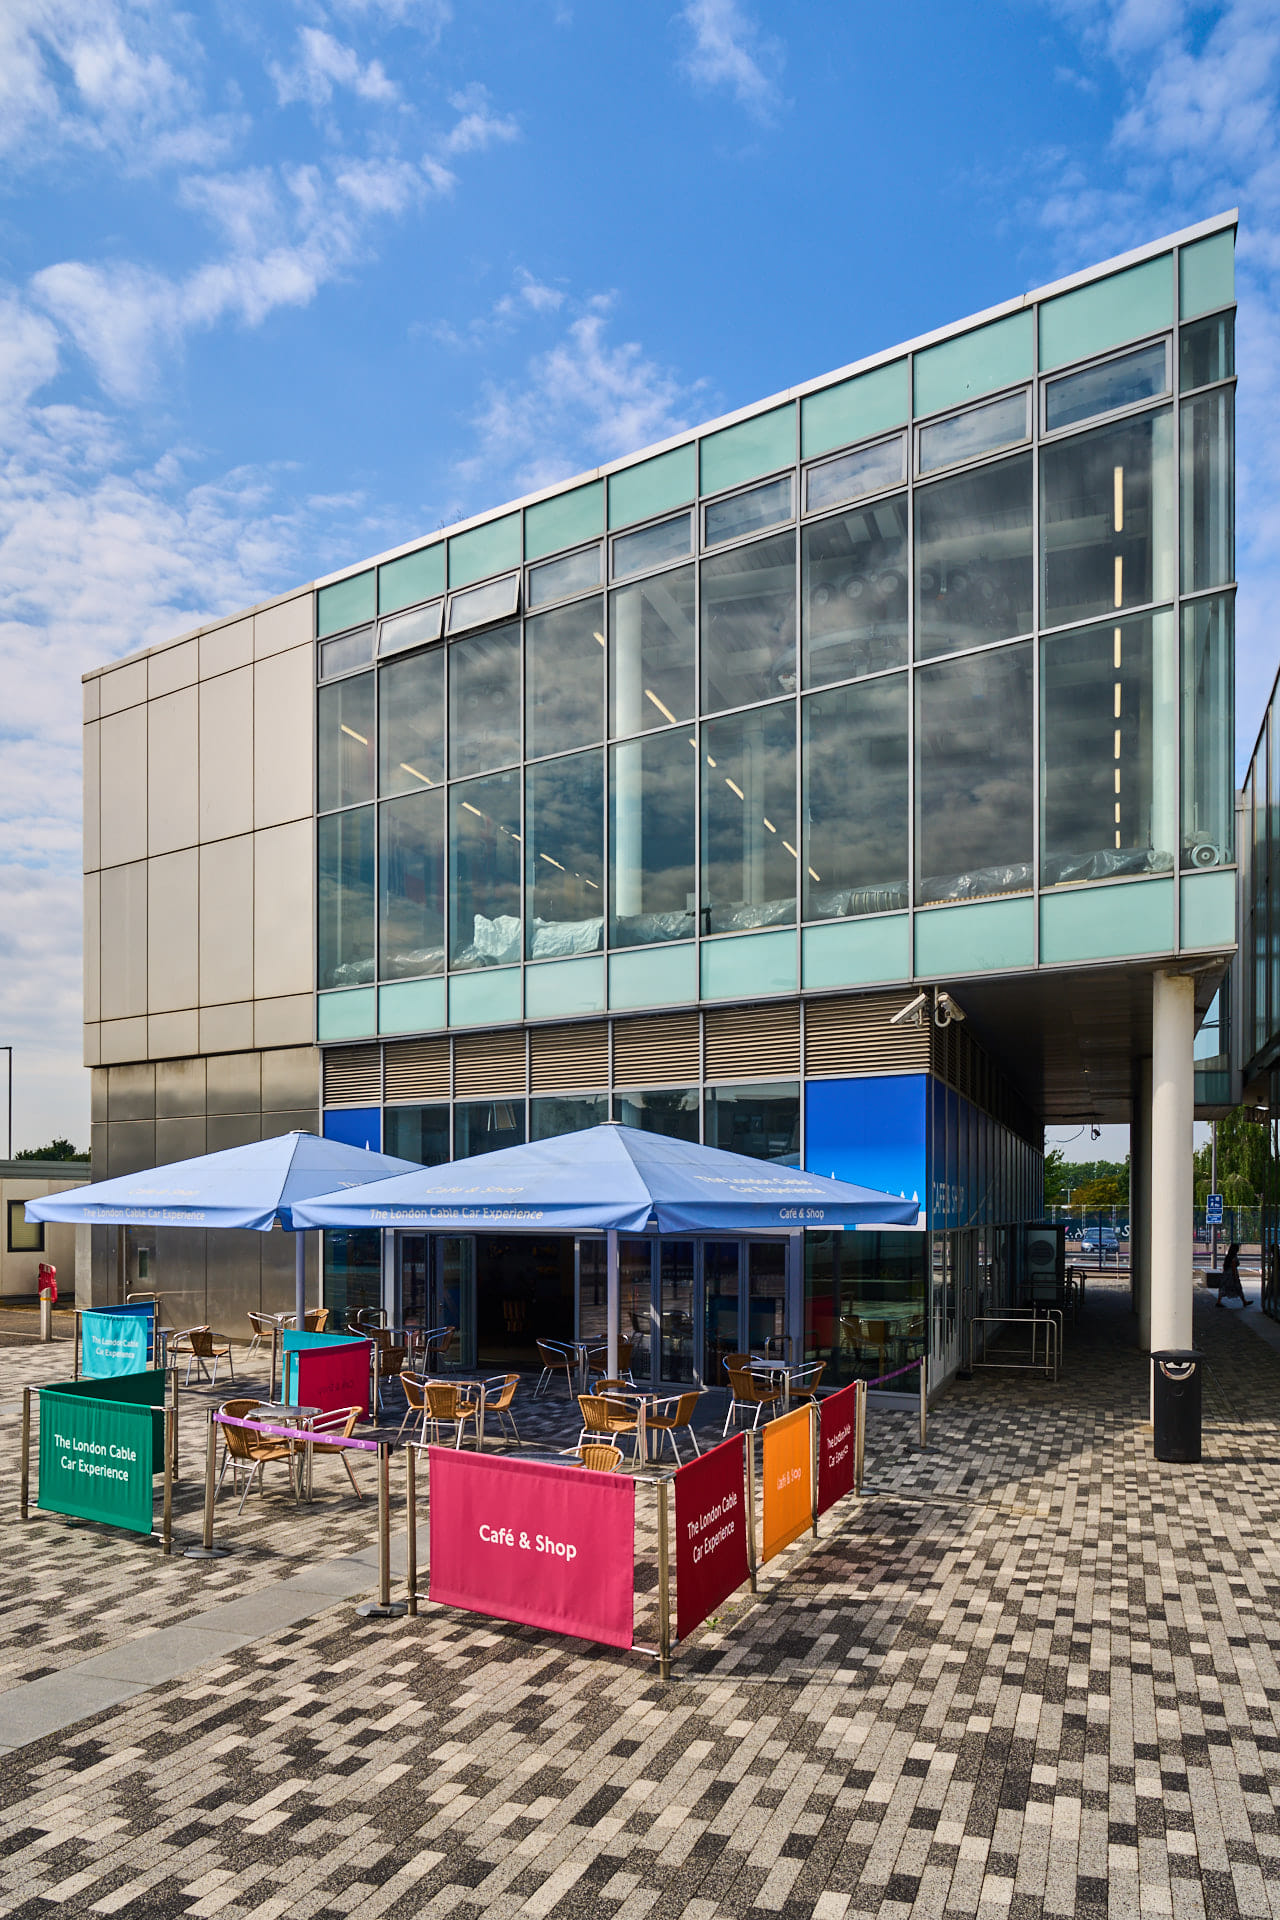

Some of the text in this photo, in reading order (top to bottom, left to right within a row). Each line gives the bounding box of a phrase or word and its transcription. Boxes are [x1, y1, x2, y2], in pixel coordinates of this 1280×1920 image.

[83, 1207, 206, 1221] The London Cable Car Experience
[370, 1207, 544, 1220] The London Cable Car Experience
[779, 1208, 825, 1220] Café & Shop
[54, 1433, 136, 1462] The London Cable
[60, 1456, 129, 1482] Car Experience
[687, 1491, 738, 1540] The London Cable
[478, 1524, 577, 1562] Café & Shop
[692, 1520, 735, 1564] Car Experience
